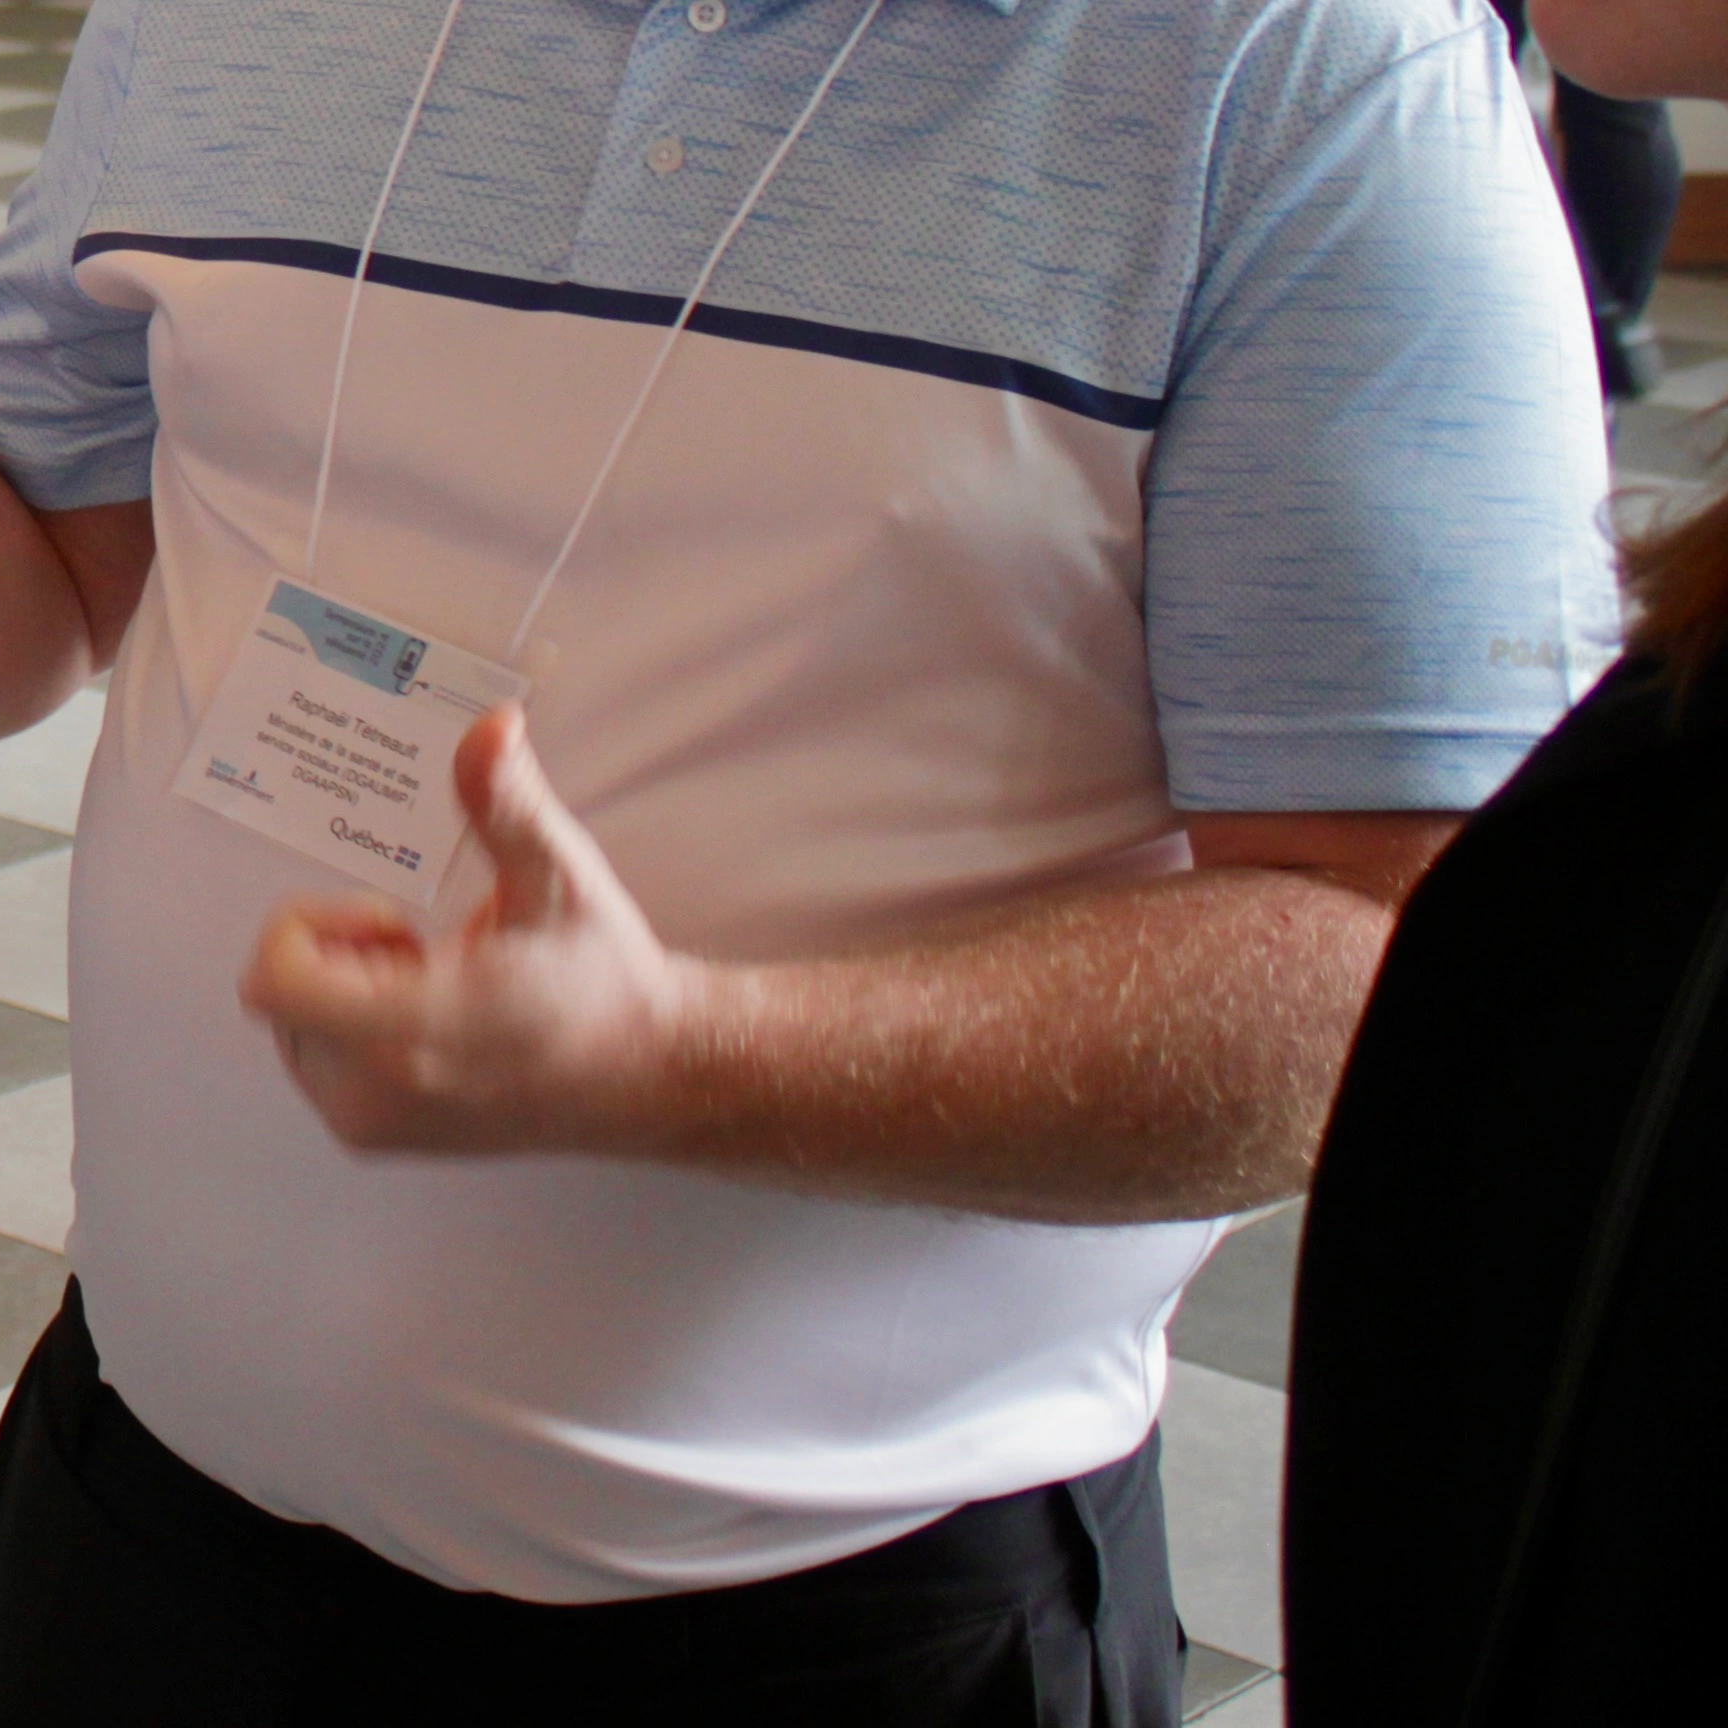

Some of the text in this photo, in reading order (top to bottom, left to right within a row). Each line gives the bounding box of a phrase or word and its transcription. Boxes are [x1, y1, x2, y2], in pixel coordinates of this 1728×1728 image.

[291, 690, 350, 728] Raphaël
[267, 712, 317, 744] Ministère
[318, 738, 333, 751] de
[349, 751, 381, 772] santé
[397, 773, 420, 791] des
[330, 816, 394, 860] Québec
